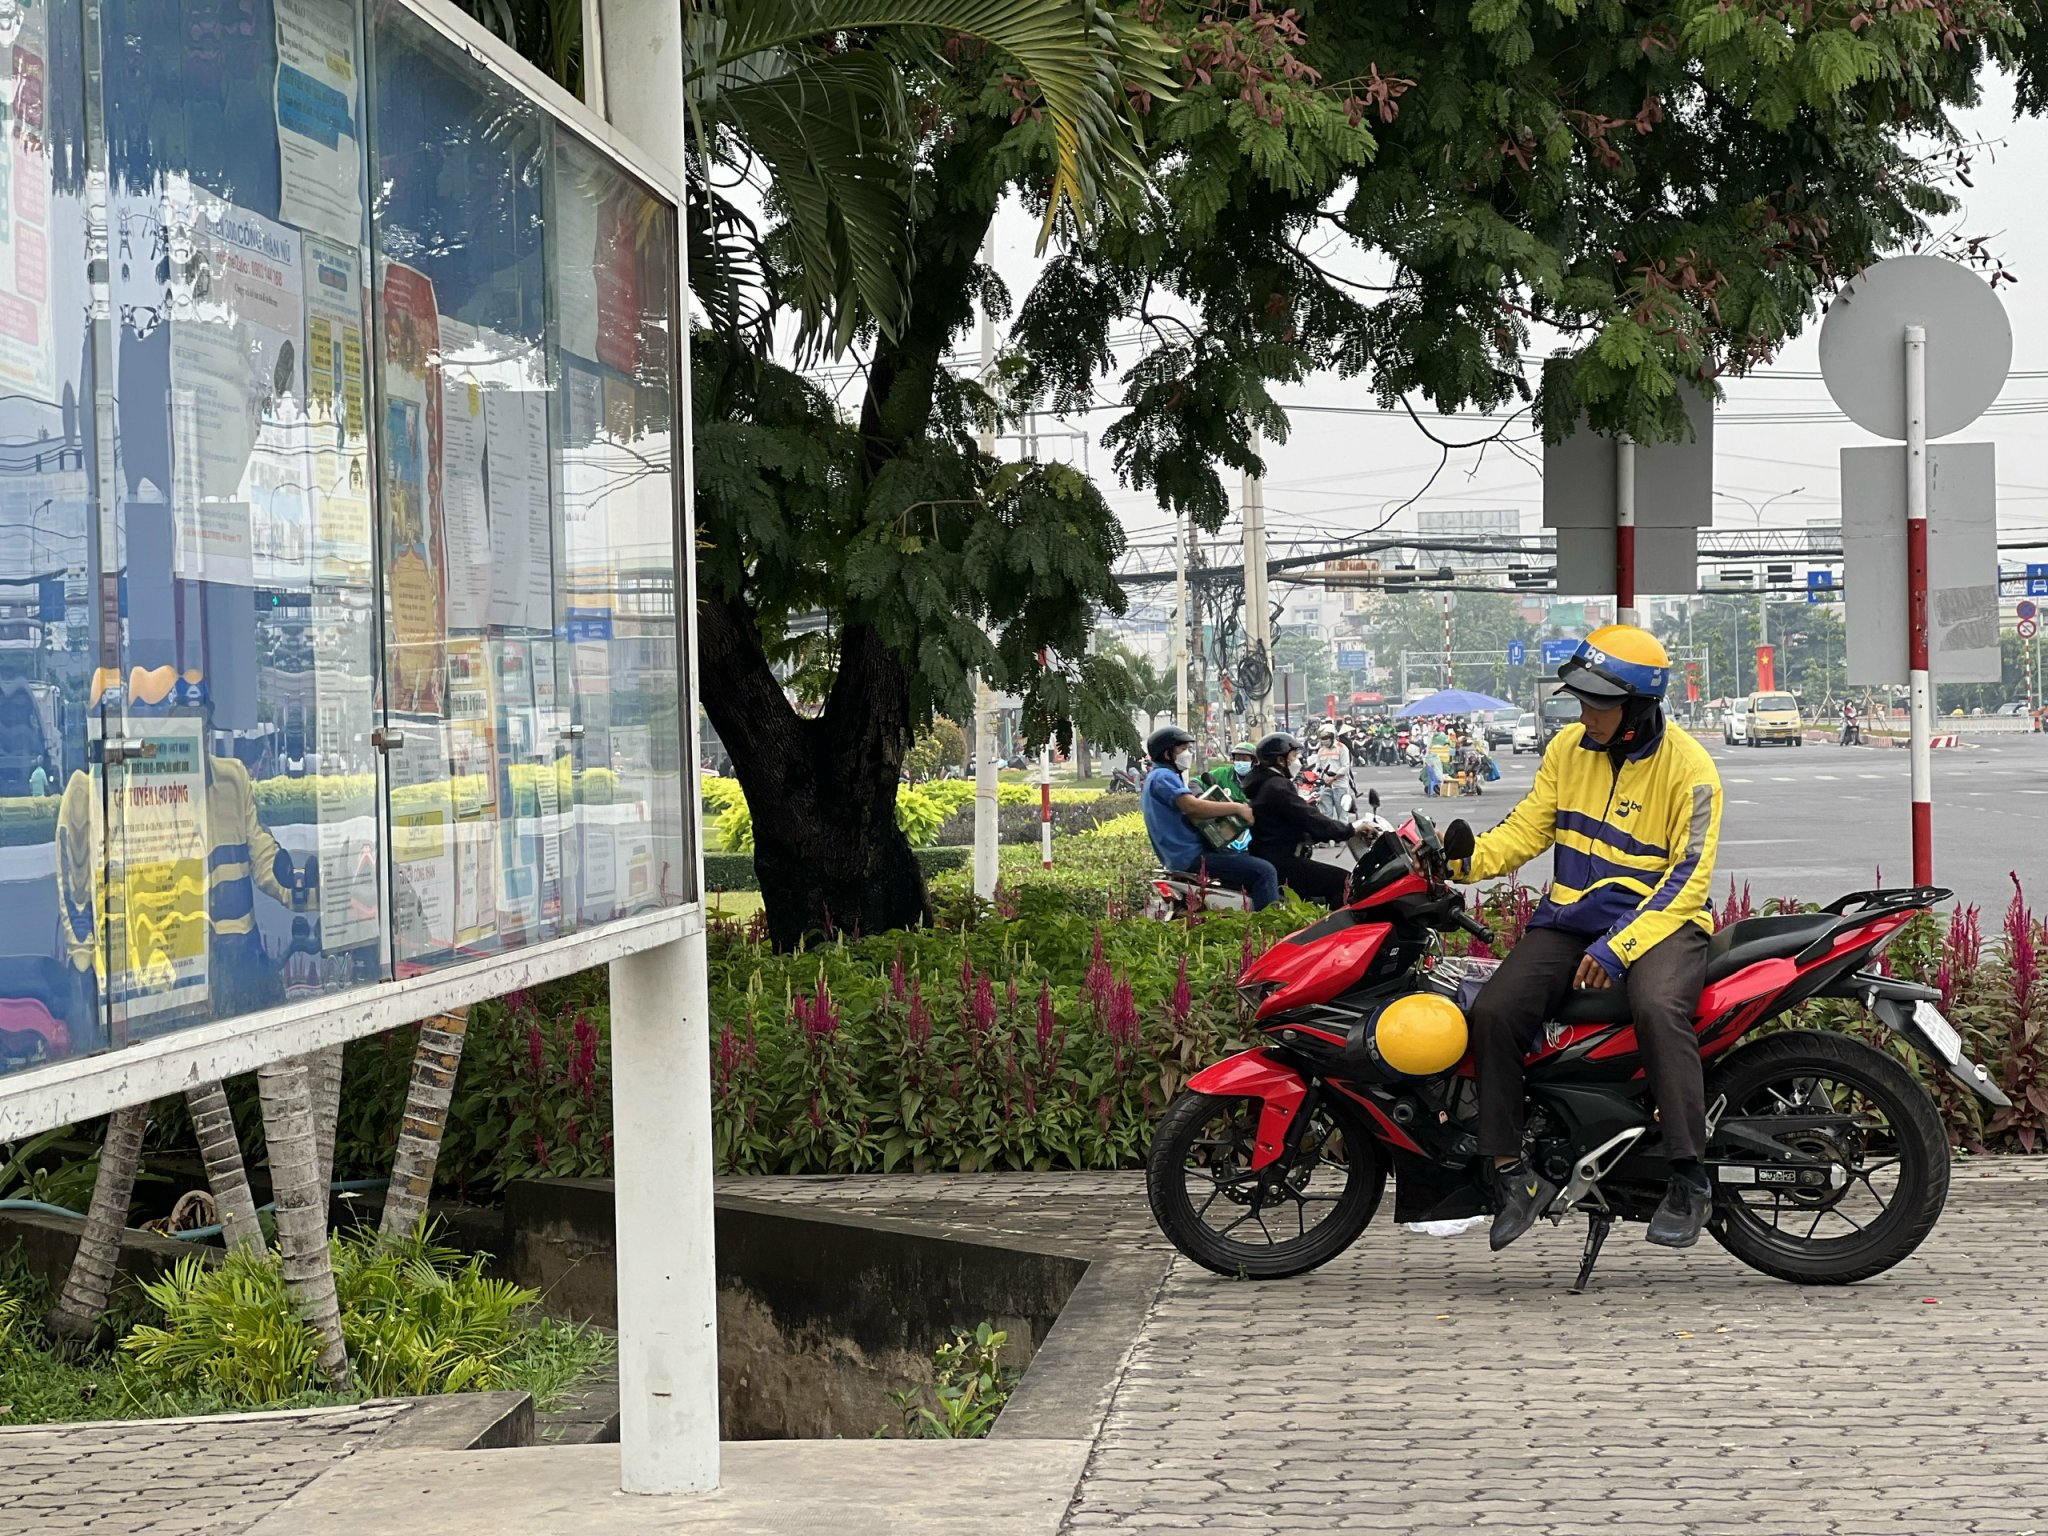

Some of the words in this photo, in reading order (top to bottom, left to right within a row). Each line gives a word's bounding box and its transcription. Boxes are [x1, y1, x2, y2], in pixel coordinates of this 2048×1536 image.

[1584, 645, 1606, 664] be
[1630, 800, 1642, 812] be
[1621, 938, 1637, 952] be
[1367, 1036, 1379, 1060] be
